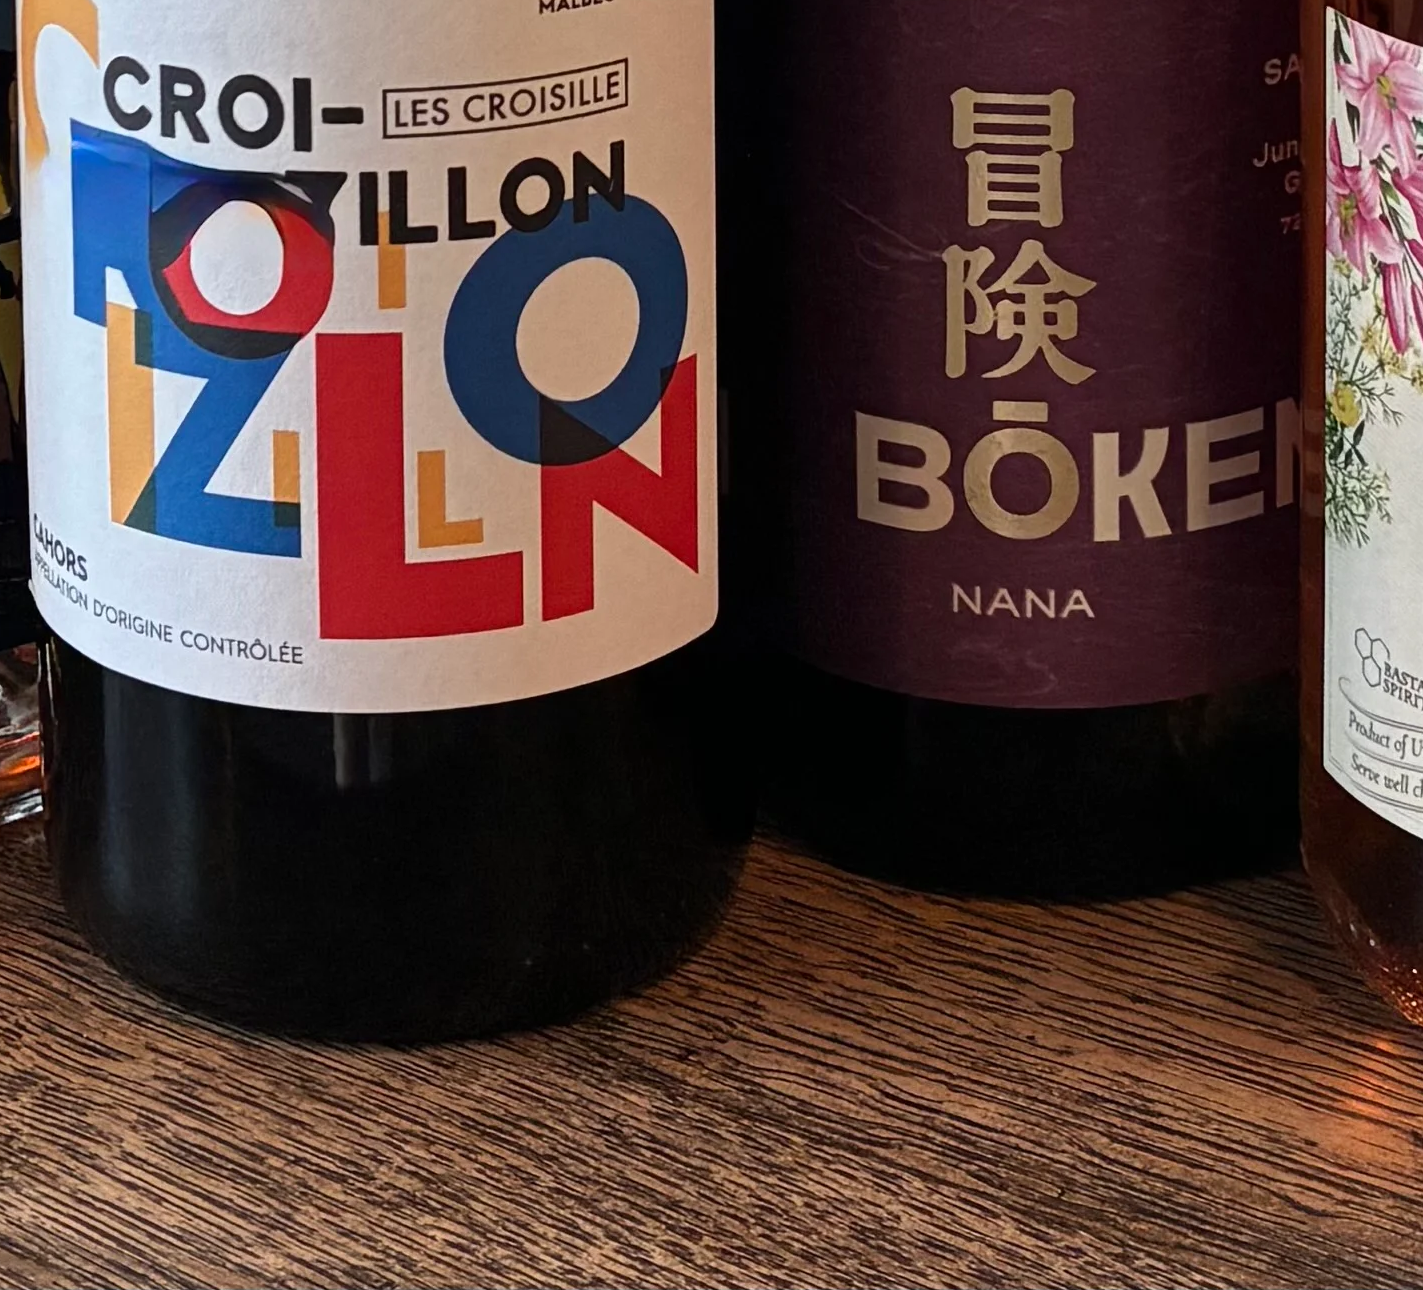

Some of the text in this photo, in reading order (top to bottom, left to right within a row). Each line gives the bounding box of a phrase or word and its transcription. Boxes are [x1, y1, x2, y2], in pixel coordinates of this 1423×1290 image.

[103, 55, 365, 153] CROI-
[394, 71, 621, 129] LES CROISILLE
[951, 582, 1097, 620] NANA
[179, 629, 304, 665] CONTRÔLÉE
[1348, 709, 1390, 749] Product
[1394, 733, 1409, 760] of
[1351, 752, 1380, 785] Serve
[1383, 773, 1409, 795] well
